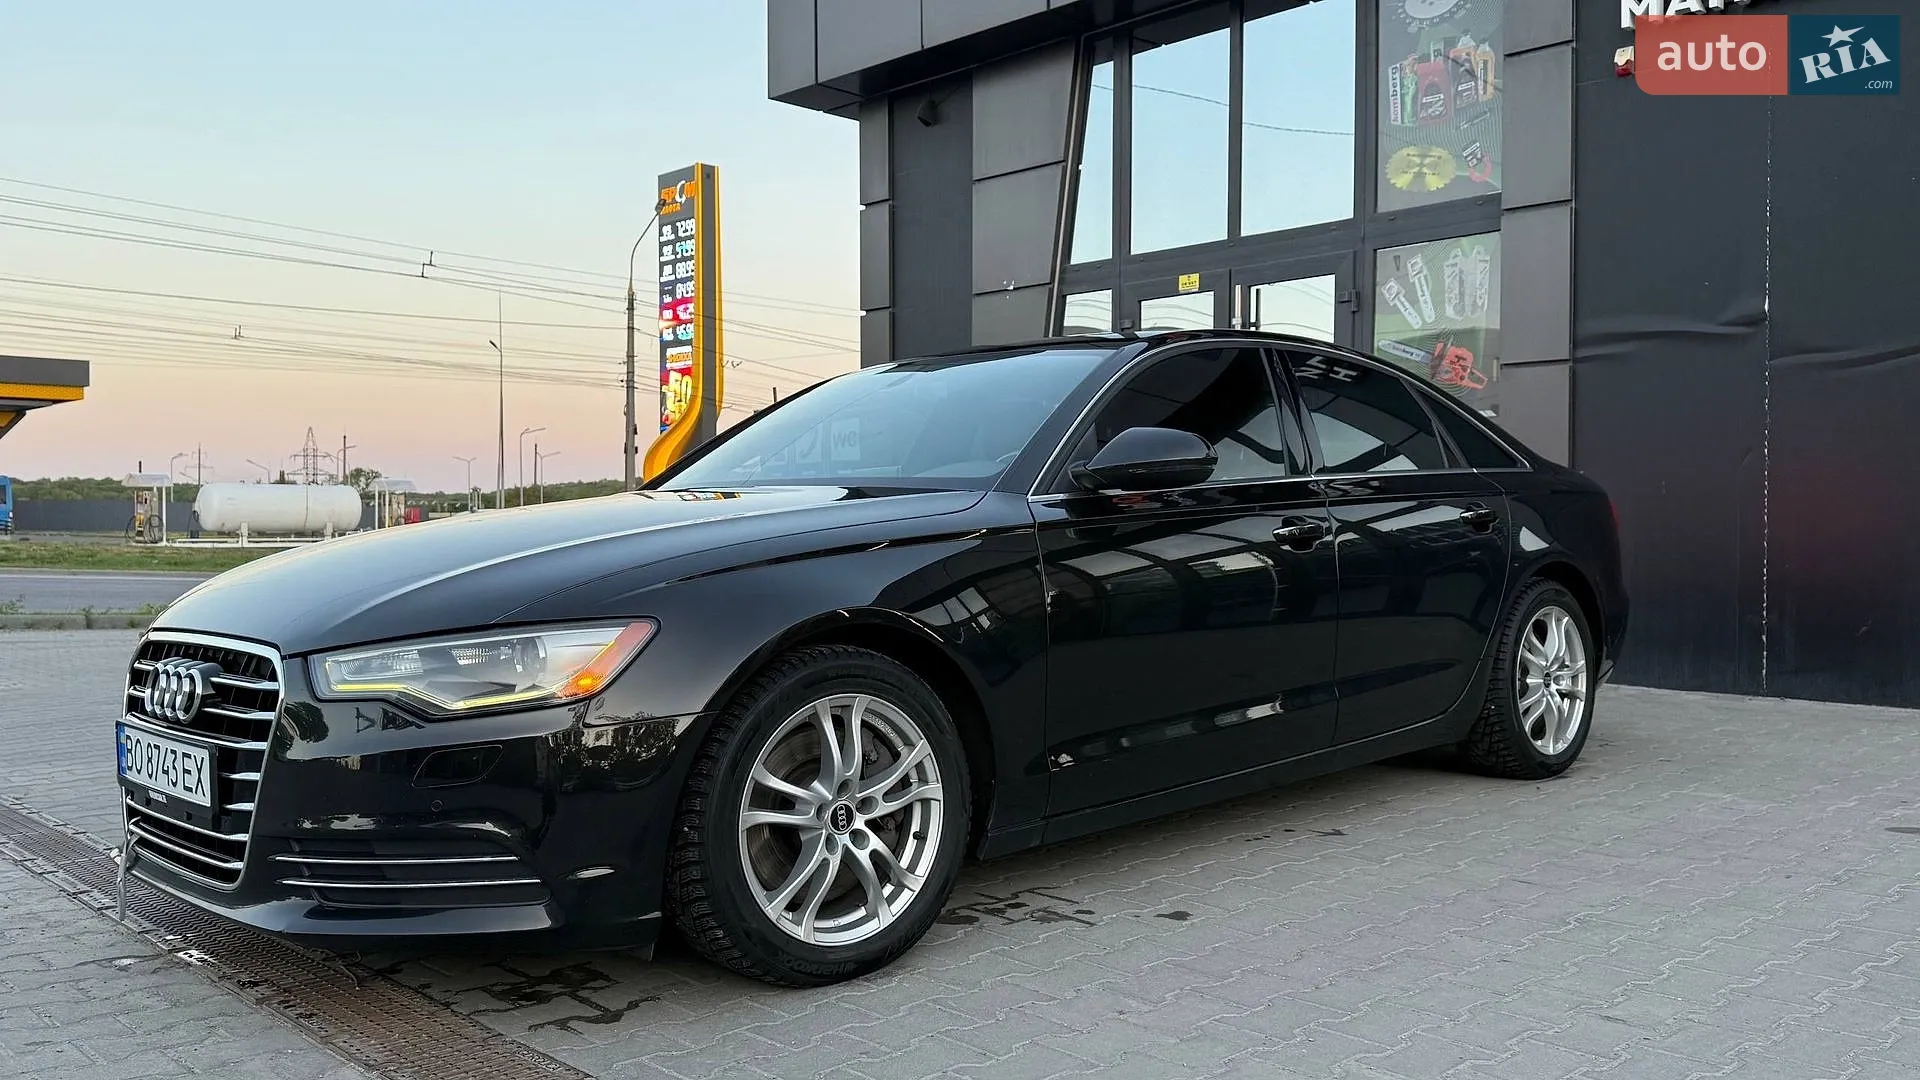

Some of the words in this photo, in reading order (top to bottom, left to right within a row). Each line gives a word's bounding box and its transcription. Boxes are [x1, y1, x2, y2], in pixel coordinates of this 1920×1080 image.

[126, 734, 143, 776] BO
[146, 741, 179, 788] 8743
[182, 751, 206, 798] EX
